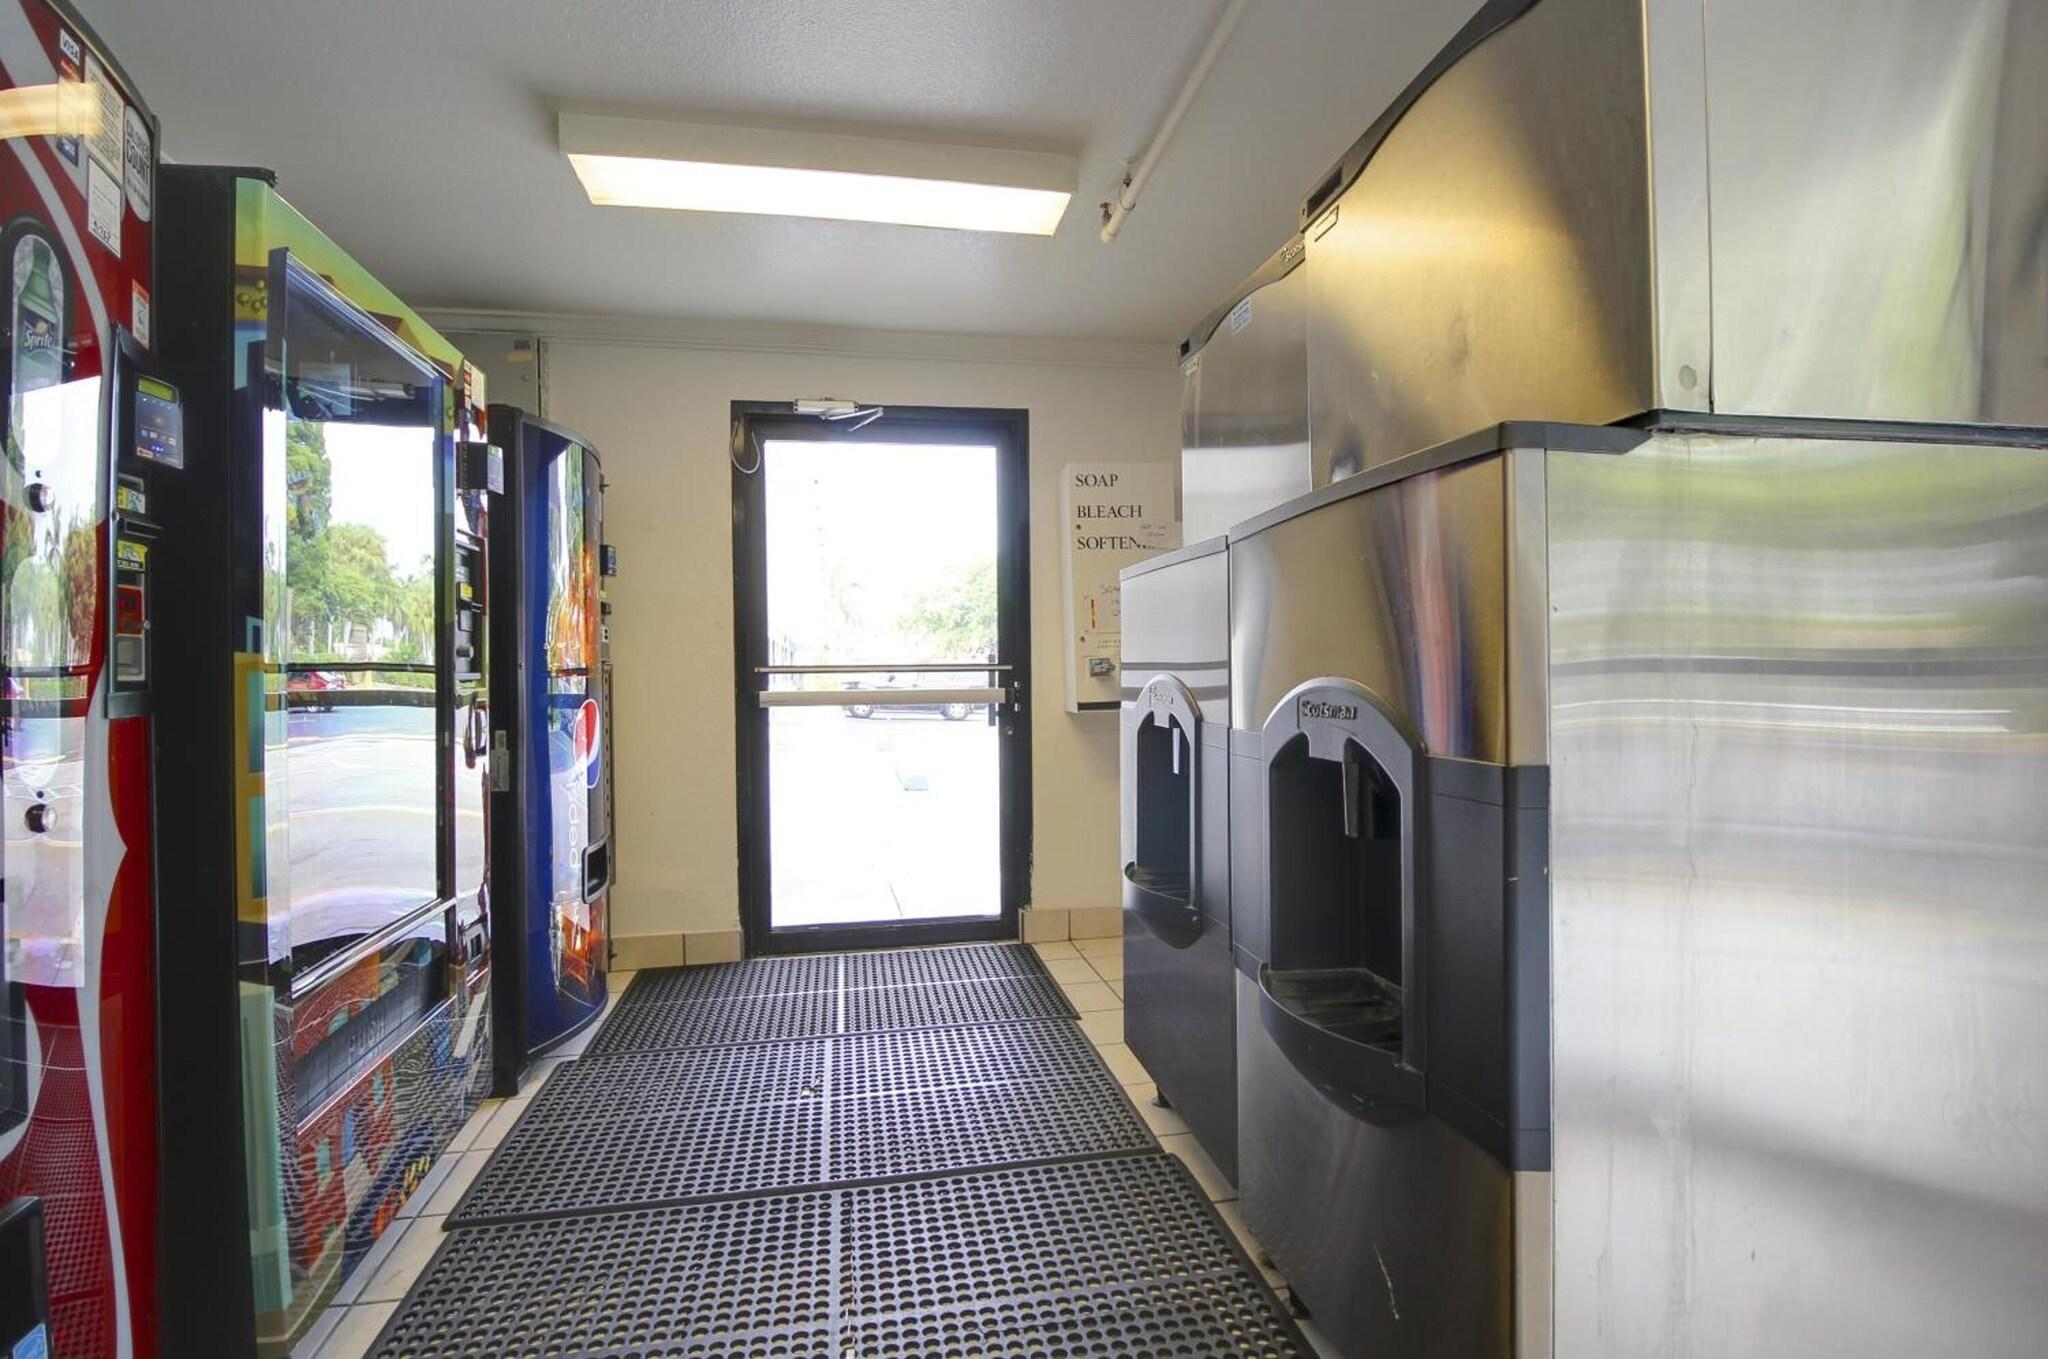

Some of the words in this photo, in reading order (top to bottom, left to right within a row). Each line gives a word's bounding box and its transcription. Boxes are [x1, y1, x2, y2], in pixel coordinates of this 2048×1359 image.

[24, 328, 52, 351] Sprite
[1075, 473, 1118, 487] SOAP
[1077, 504, 1142, 519] BLEACH
[1077, 536, 1146, 549] SOFTEN
